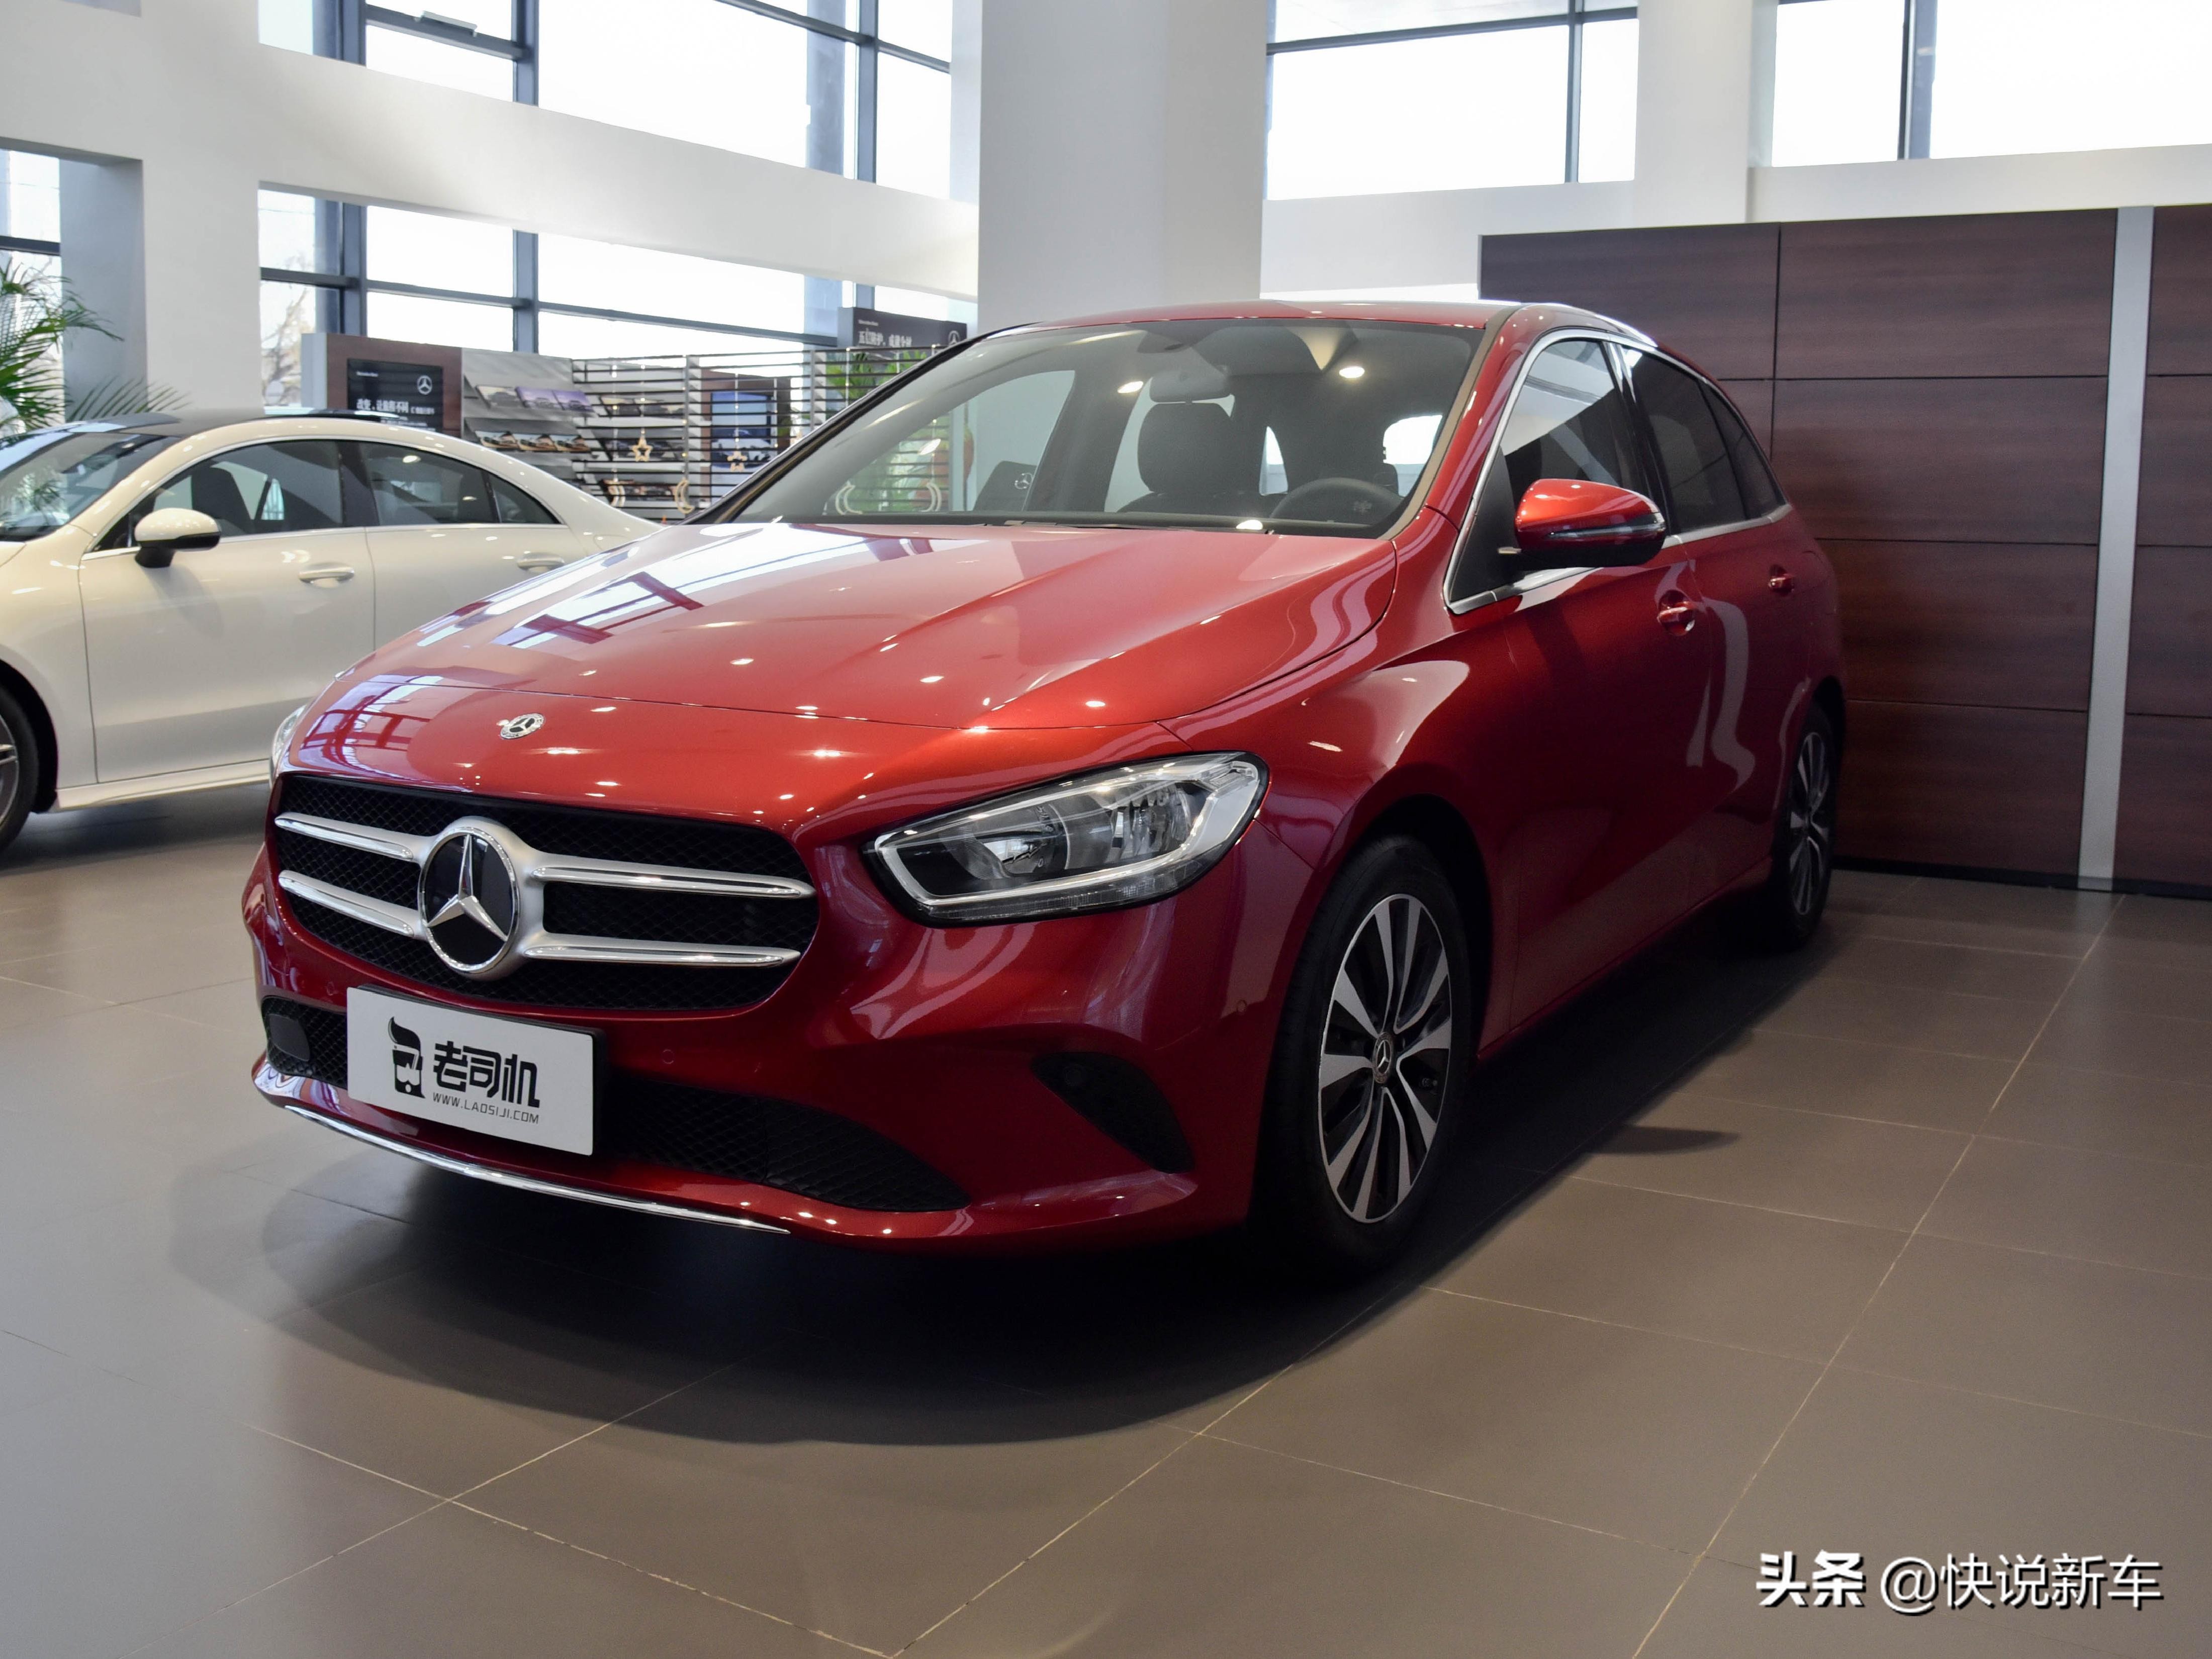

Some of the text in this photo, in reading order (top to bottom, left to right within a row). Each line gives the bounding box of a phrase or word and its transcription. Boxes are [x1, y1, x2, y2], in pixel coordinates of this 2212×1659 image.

[433, 1041, 540, 1108] 老司机
[433, 1092, 539, 1124] WWW.LAOSIJI.COM
